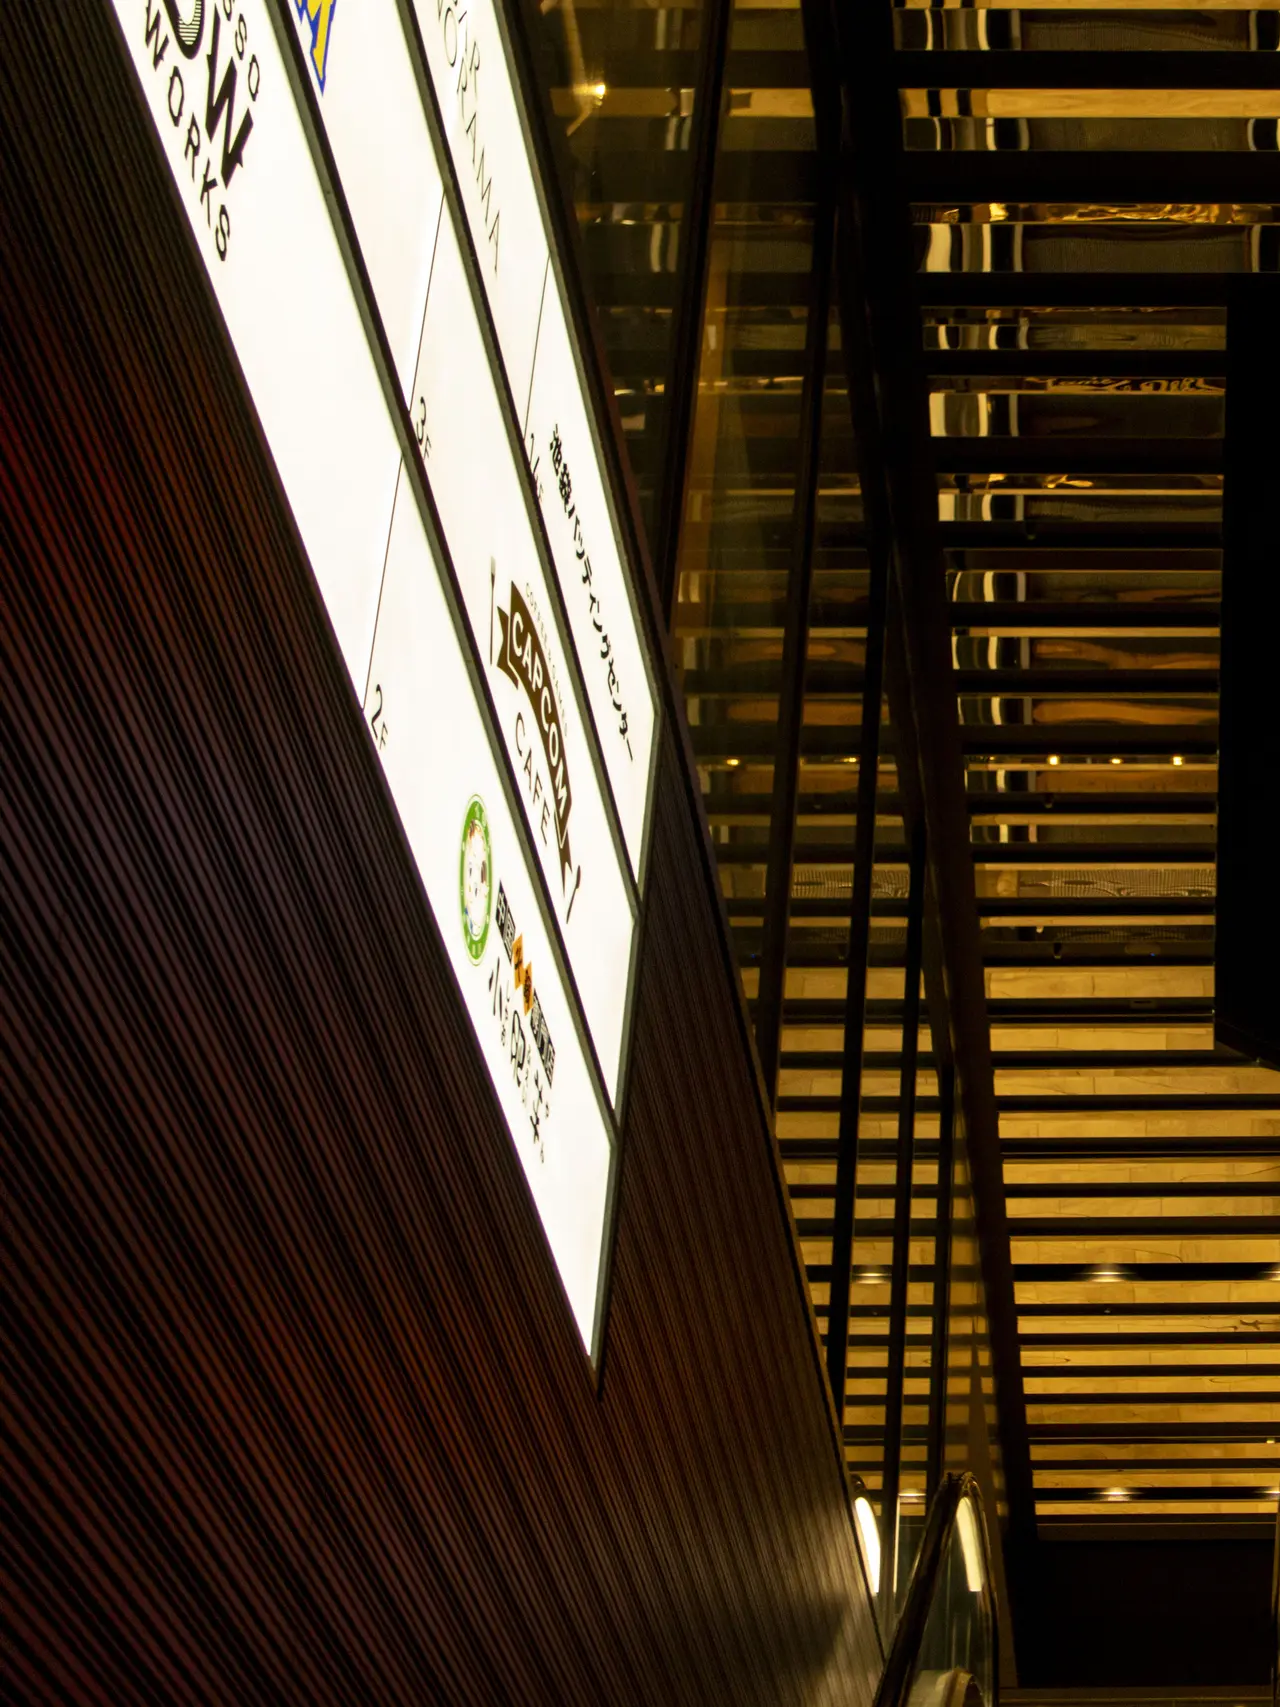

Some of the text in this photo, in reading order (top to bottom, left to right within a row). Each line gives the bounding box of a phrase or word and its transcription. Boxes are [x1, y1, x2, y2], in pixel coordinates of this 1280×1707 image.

[144, 0, 230, 261] WORKS
[511, 611, 569, 820] CAPCOM
[515, 712, 551, 847] CAFE
